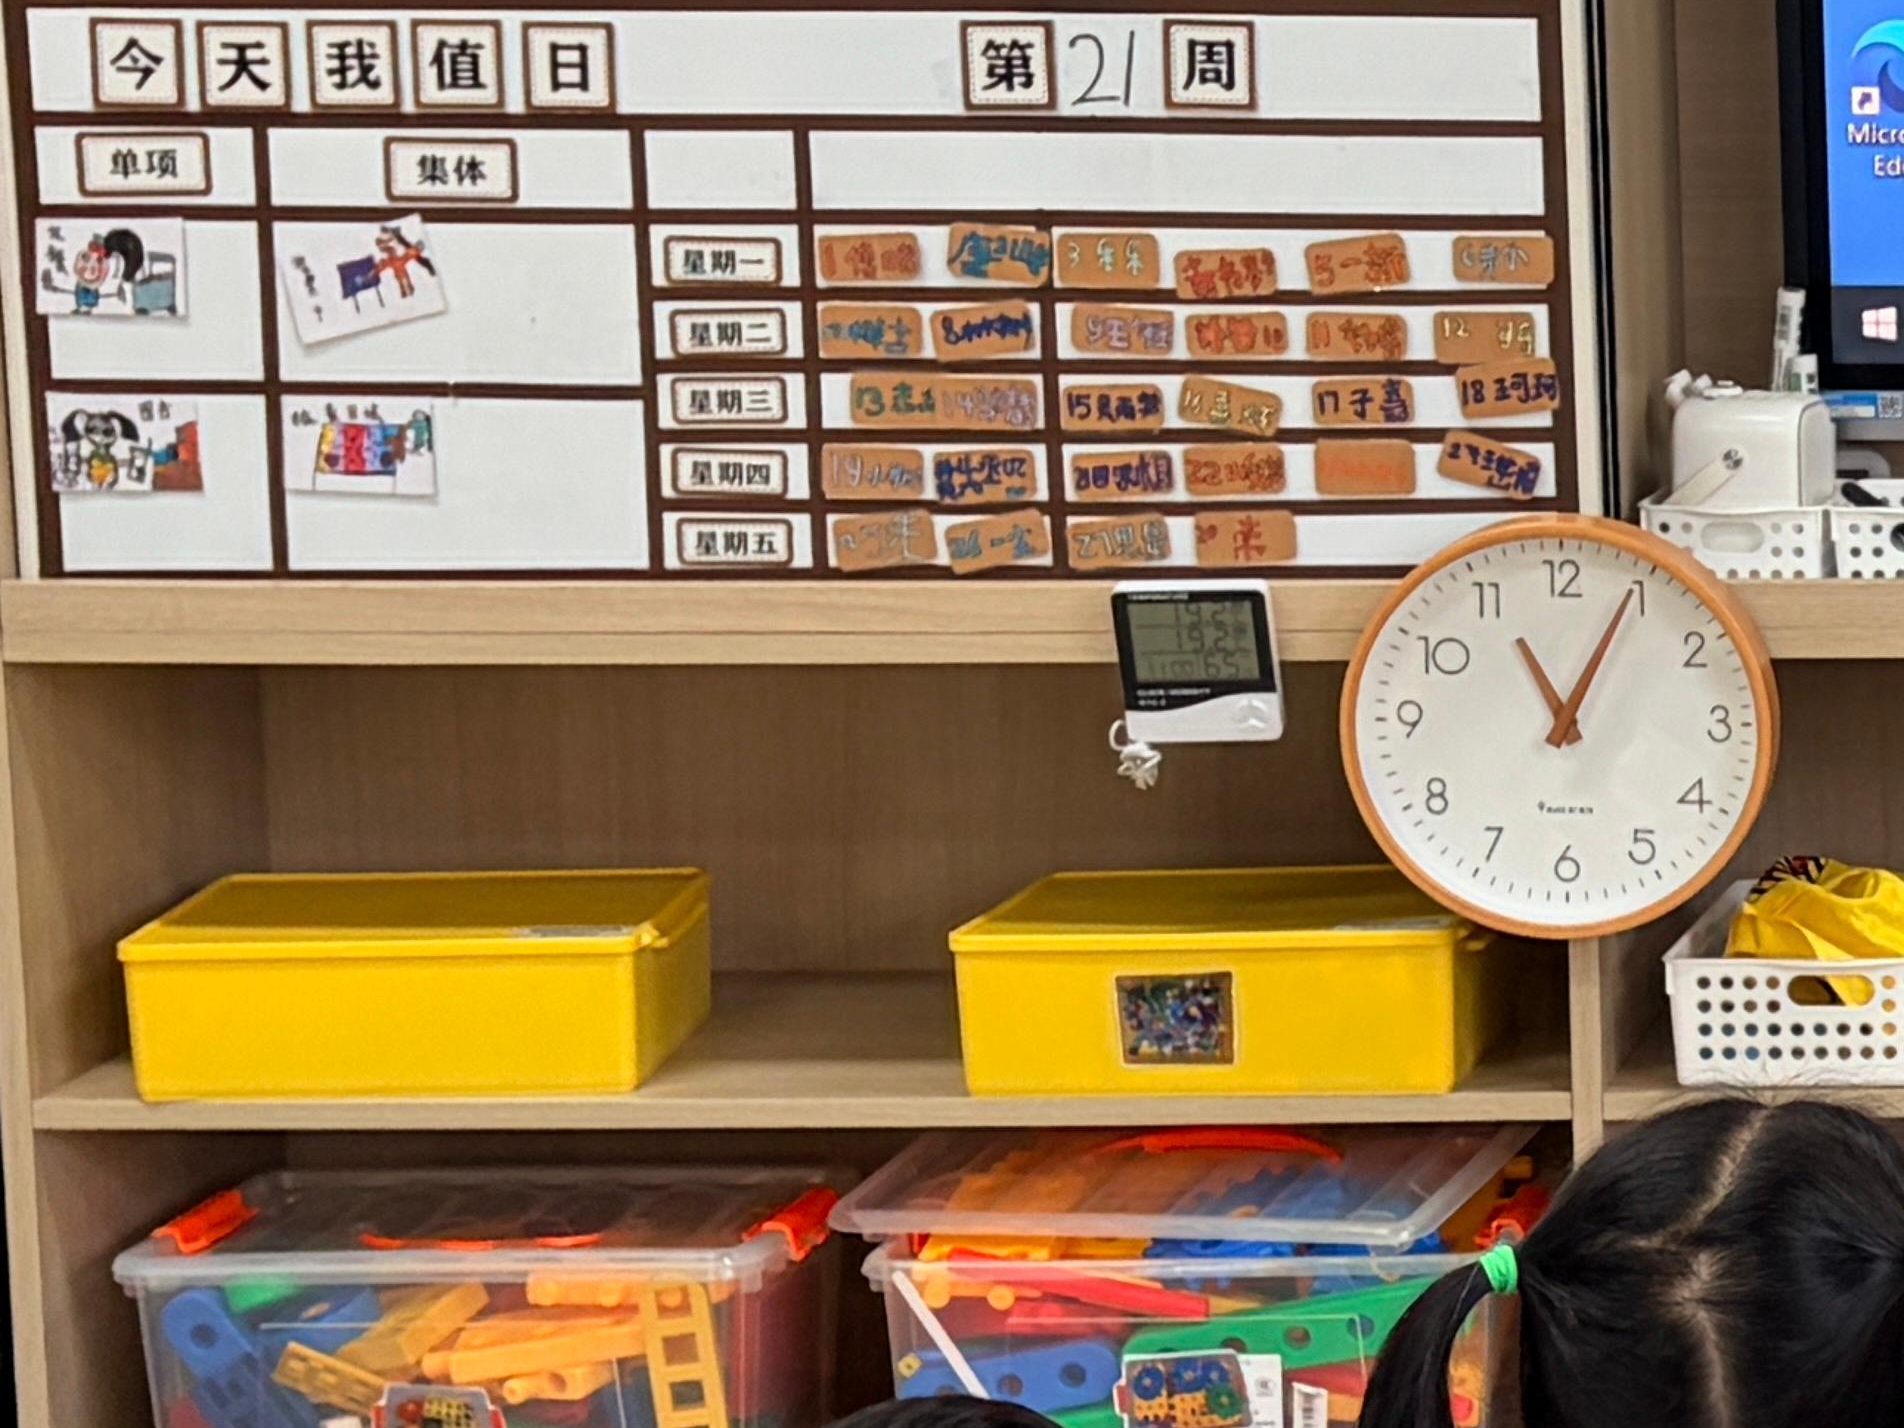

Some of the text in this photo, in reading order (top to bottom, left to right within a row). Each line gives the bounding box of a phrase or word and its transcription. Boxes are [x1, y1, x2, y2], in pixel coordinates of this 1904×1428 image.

[108, 35, 596, 95] 今天我值日
[107, 147, 178, 182] 单项
[416, 155, 485, 189] 集体
[681, 249, 767, 274] 星期一
[688, 320, 773, 347] 星期二
[688, 388, 774, 415] 星期三
[690, 460, 772, 488] 星期四
[694, 529, 779, 558] 星期五
[1542, 559, 1583, 598] 12
[1472, 581, 1501, 619] 11
[1631, 579, 1646, 618] 1
[1417, 635, 1471, 675] 10
[1682, 630, 1708, 668] 2
[1396, 699, 1424, 739] 9
[1706, 704, 1733, 743] 3
[1425, 776, 1449, 816] 8
[1676, 776, 1714, 814] 4
[1484, 825, 1505, 863] 7
[1627, 828, 1656, 866] 5
[1553, 844, 1581, 883] 6
